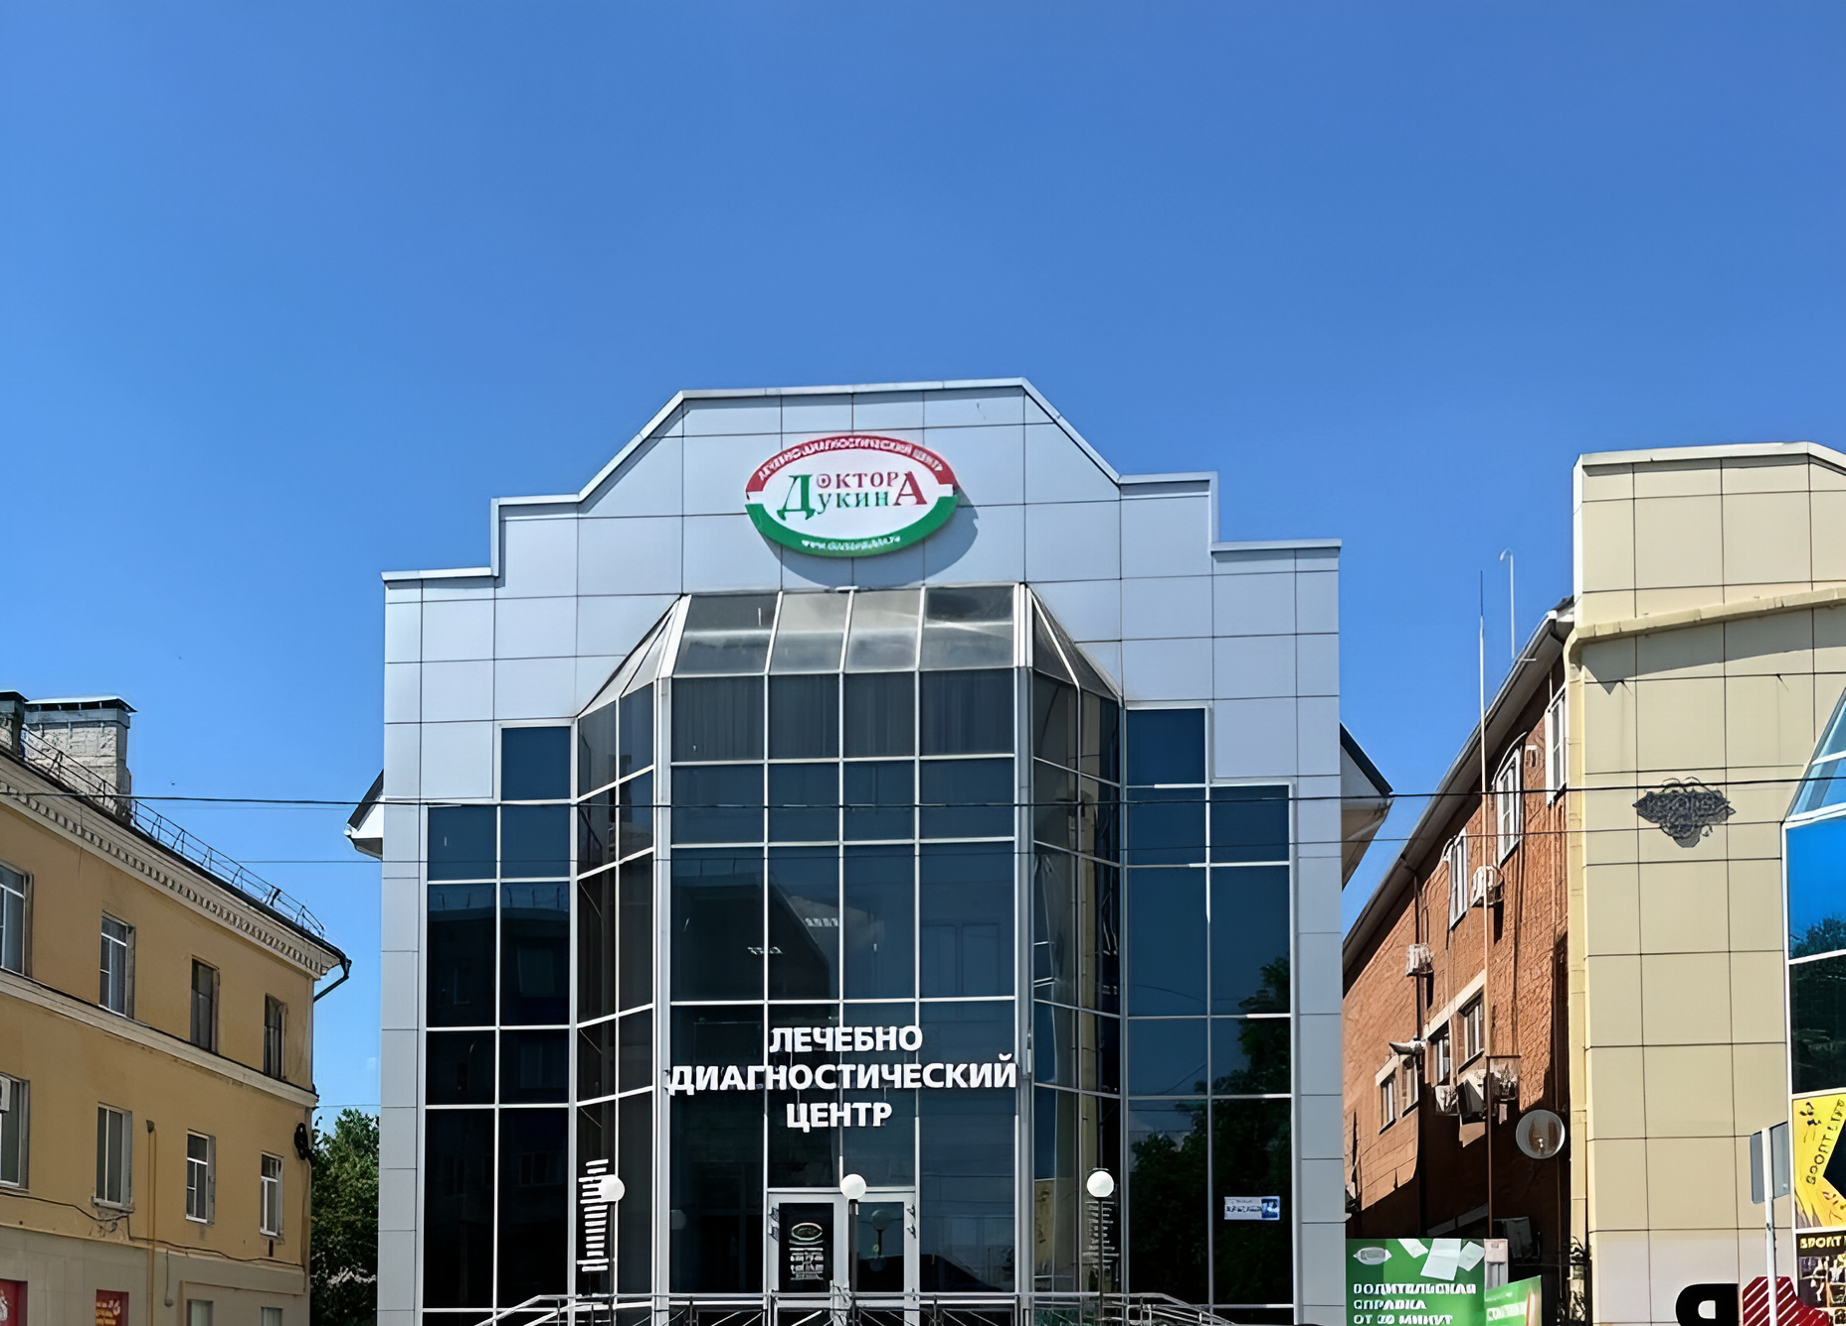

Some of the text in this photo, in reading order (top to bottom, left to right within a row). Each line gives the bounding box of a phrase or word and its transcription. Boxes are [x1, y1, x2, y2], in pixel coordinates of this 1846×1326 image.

[769, 1025, 923, 1052] ЛЕЧЕБНО
[669, 1053, 1016, 1096] ДИАГНОСТИЧЕСКИЙ
[786, 1102, 892, 1133] ЦЕНТР
[1800, 1236, 1842, 1249] SPORT
[1353, 1299, 1427, 1310] СПРАВКА
